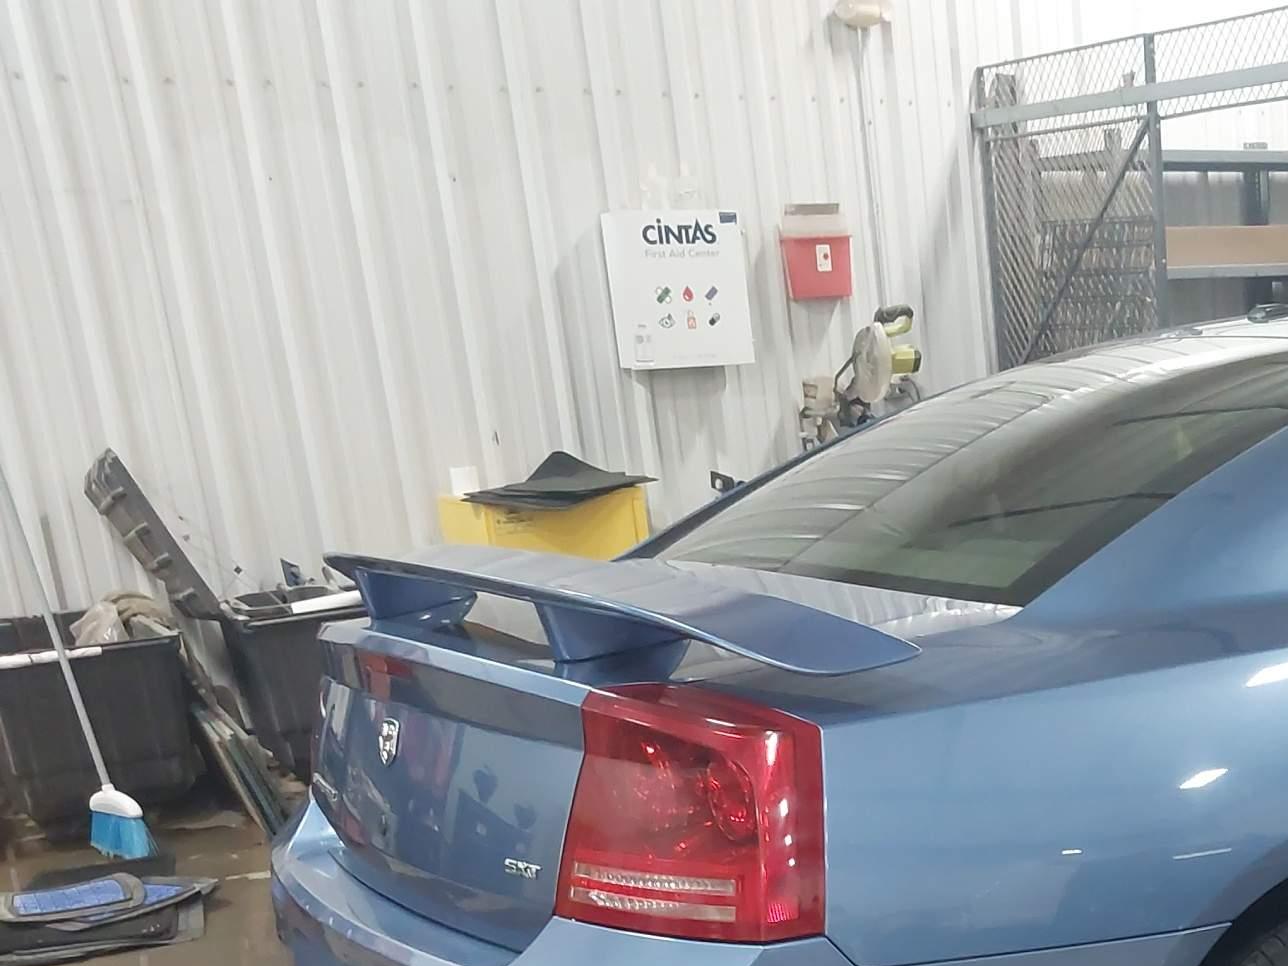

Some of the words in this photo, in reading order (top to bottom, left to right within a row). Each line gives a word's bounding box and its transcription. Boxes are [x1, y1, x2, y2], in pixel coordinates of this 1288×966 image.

[645, 249, 666, 257] First
[669, 249, 685, 257] Aid
[688, 249, 720, 257] Center
[504, 858, 541, 880] SXT
